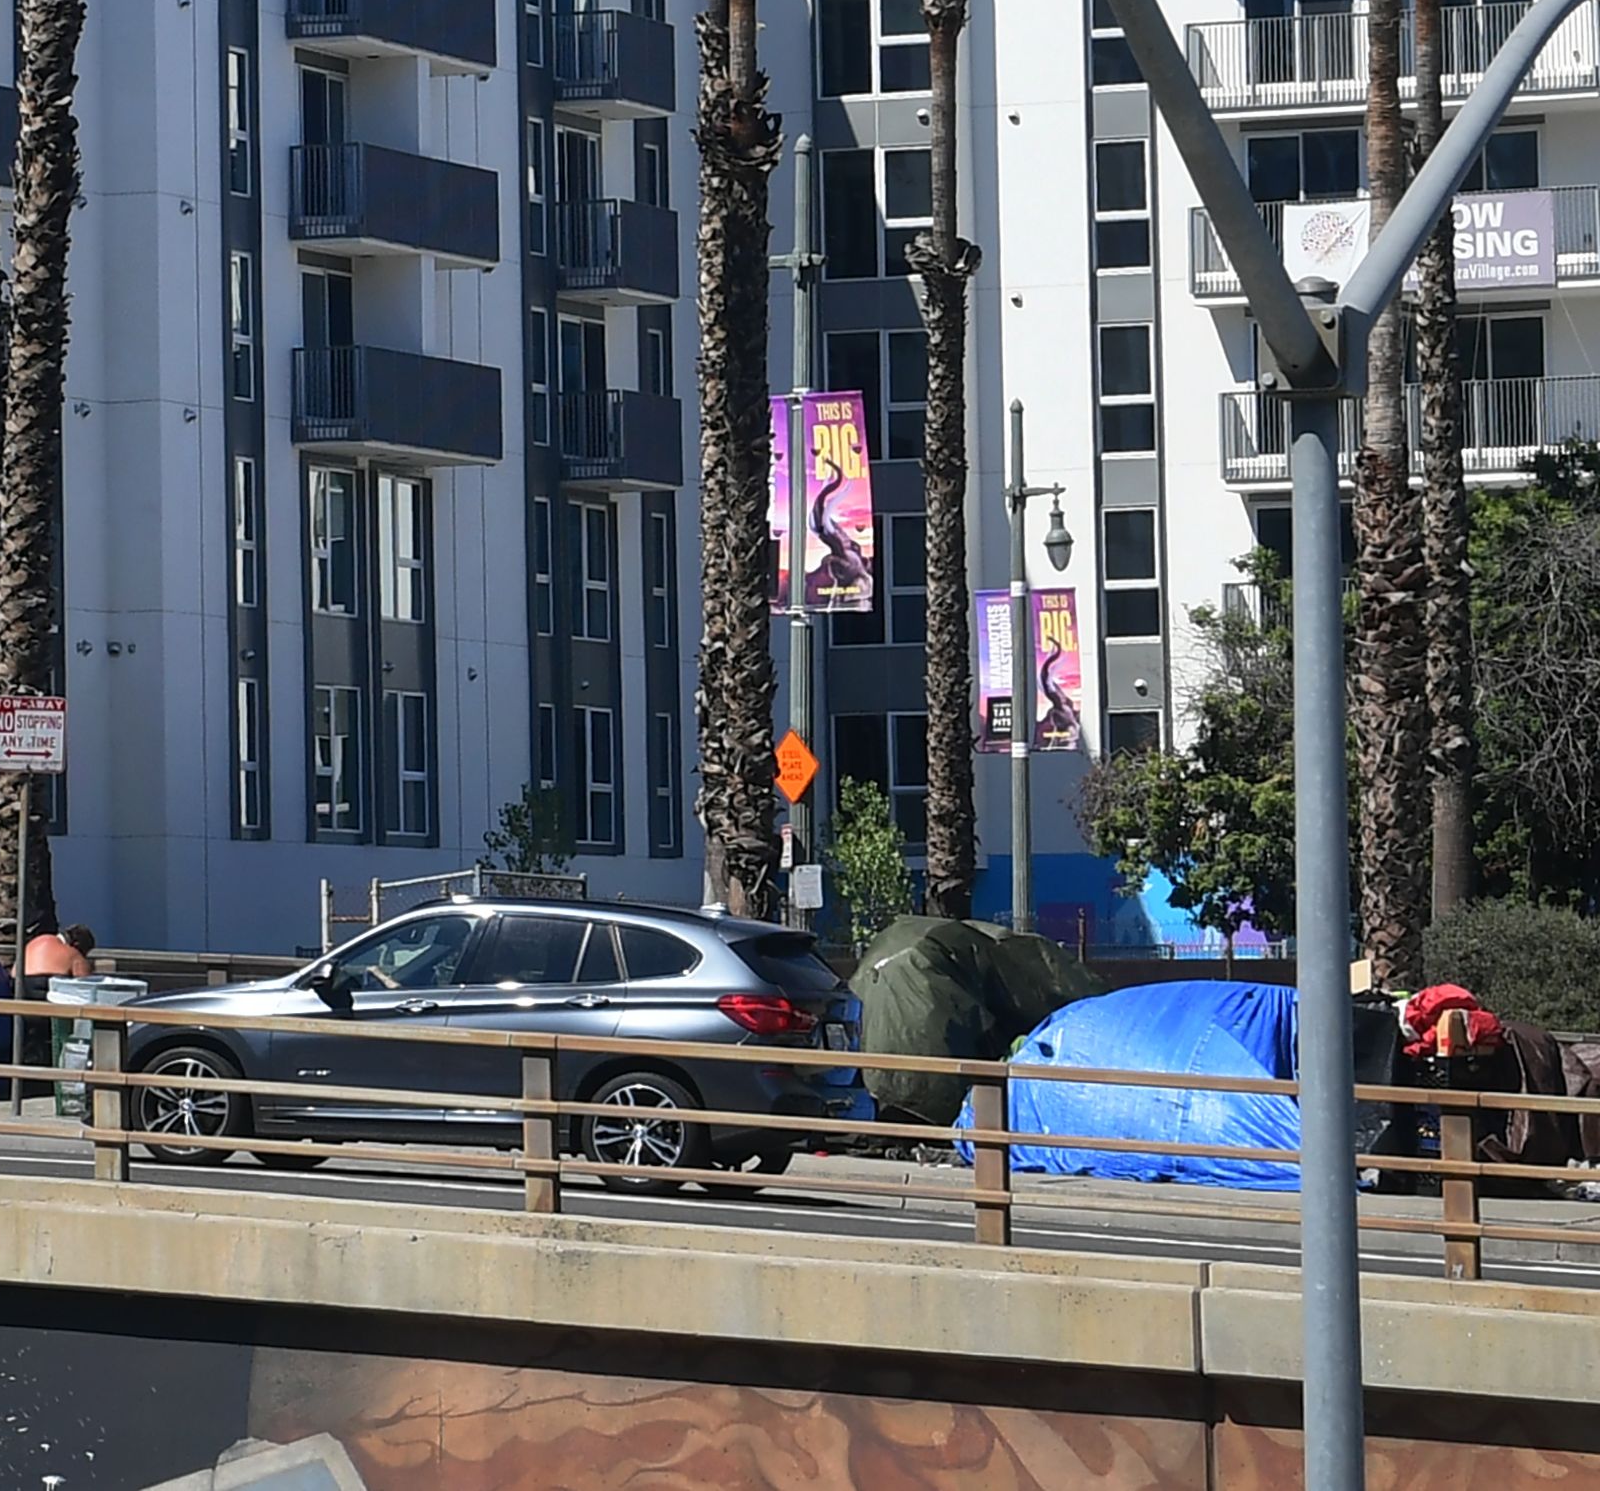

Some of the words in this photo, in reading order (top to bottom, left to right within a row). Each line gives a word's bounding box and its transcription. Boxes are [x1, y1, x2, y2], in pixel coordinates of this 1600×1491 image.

[1451, 201, 1504, 230] OW
[1453, 229, 1538, 259] SING
[1457, 263, 1539, 281] zaVillage.com
[816, 402, 840, 421] THIS
[841, 401, 853, 420] IS
[813, 423, 868, 481] BIG.
[1041, 595, 1059, 608] THIS
[1039, 610, 1078, 652] BIG.
[16, 714, 63, 730] STOPPING
[993, 708, 1012, 718] TAR
[992, 718, 1012, 728] PITS
[1, 735, 24, 748] ANY
[31, 735, 57, 749] TIME
